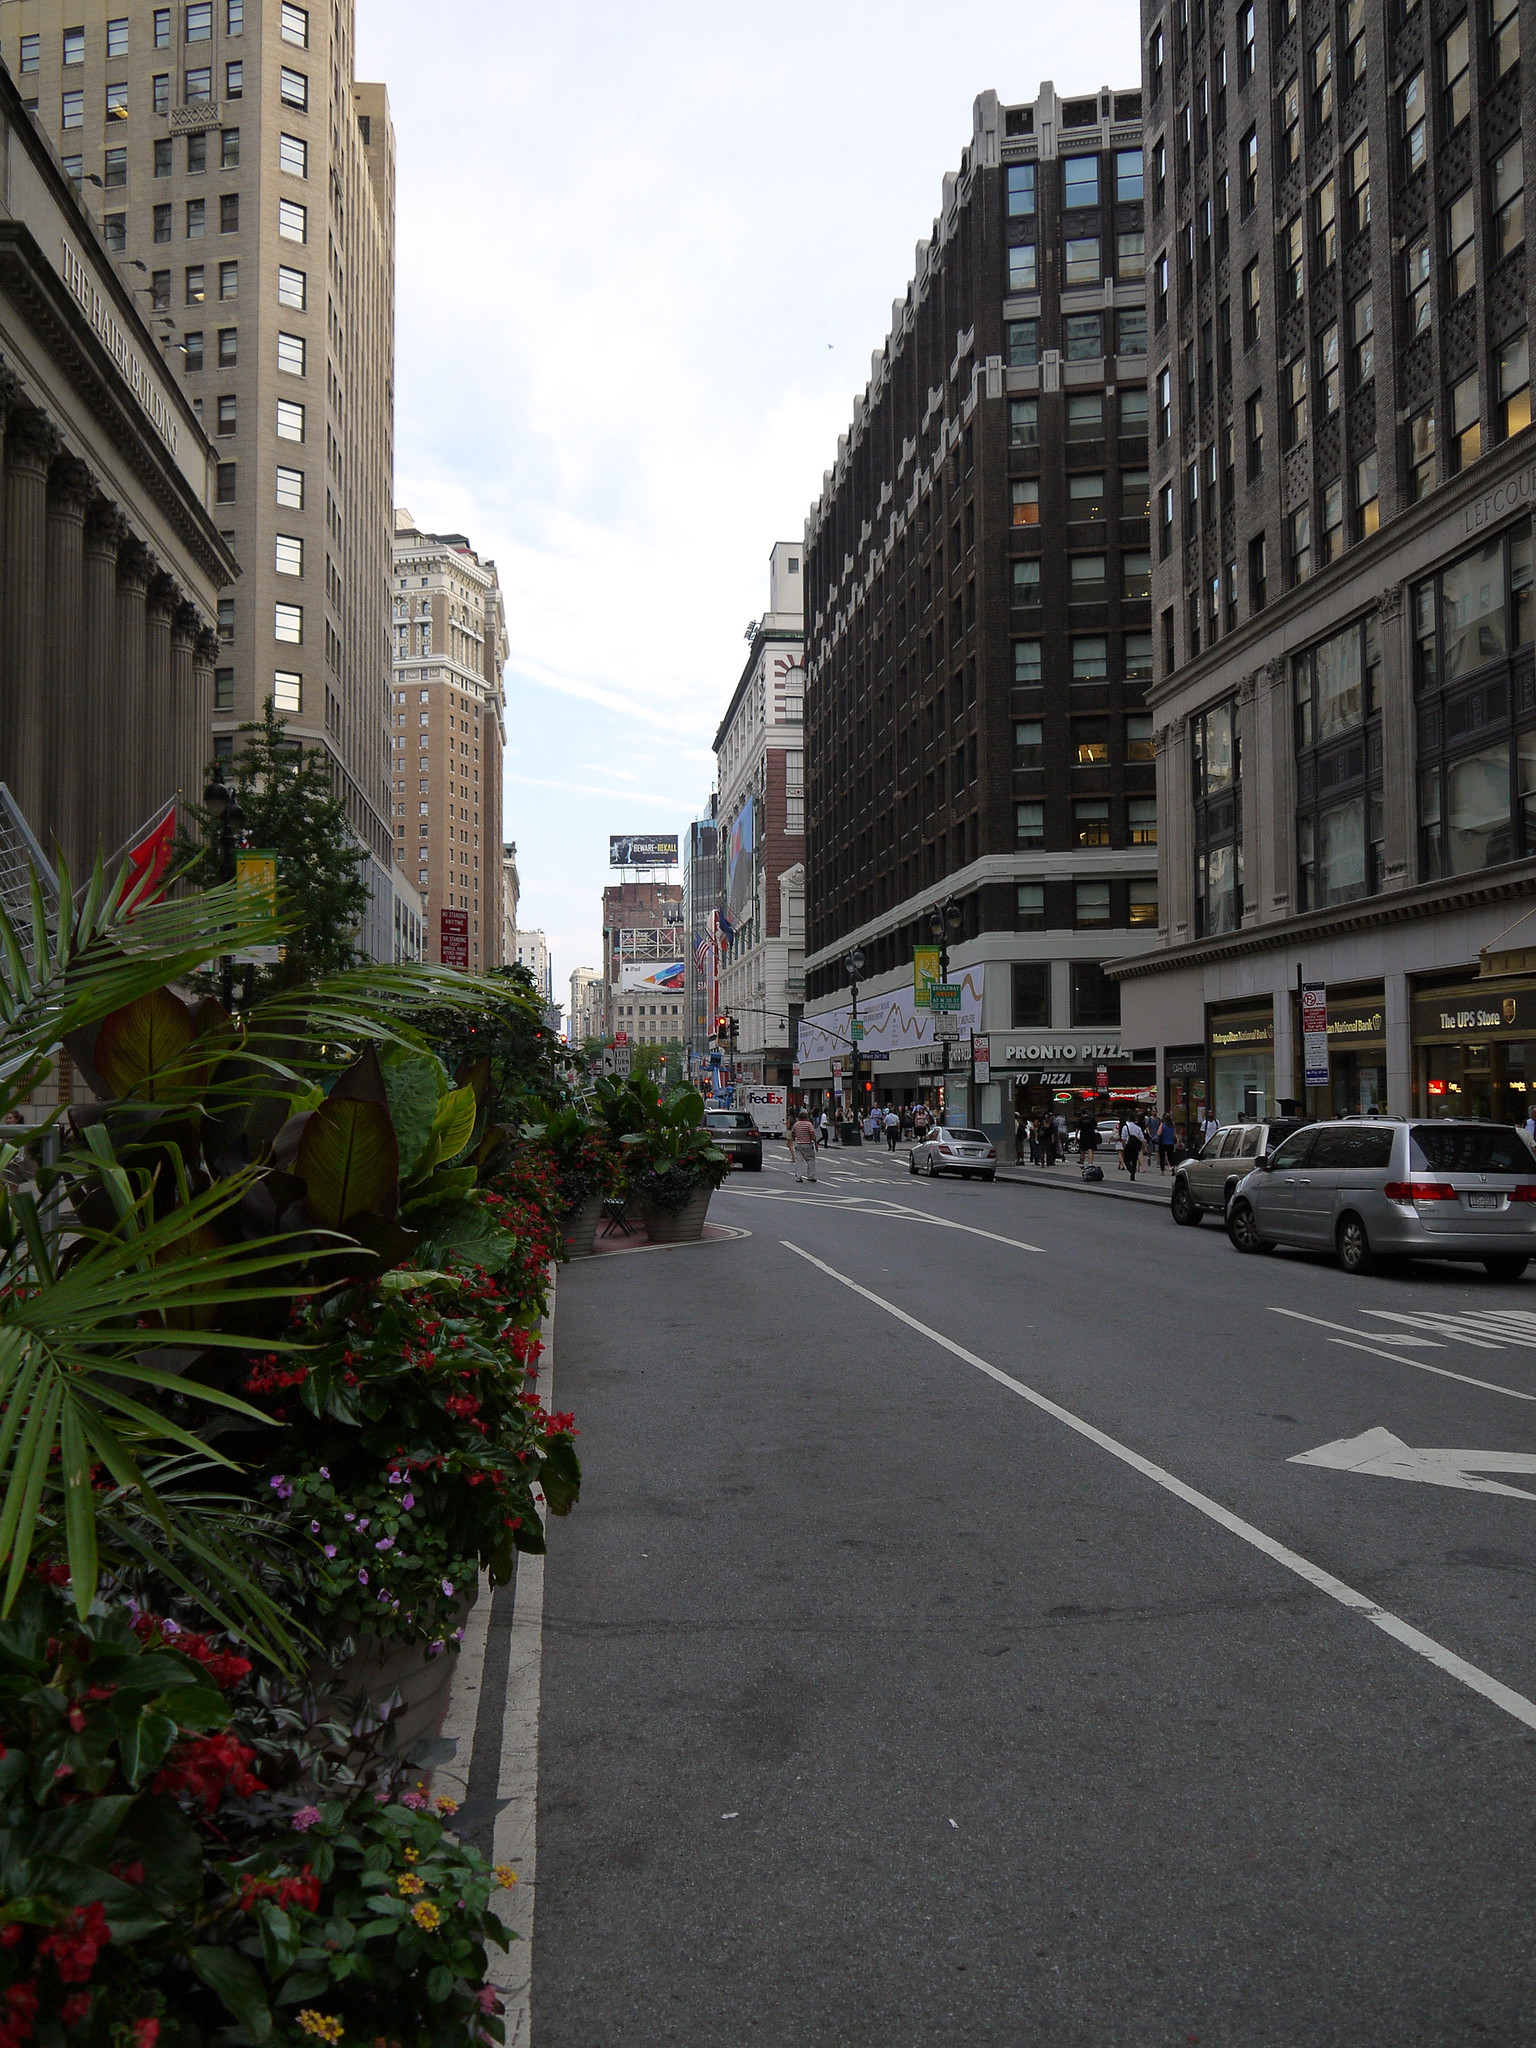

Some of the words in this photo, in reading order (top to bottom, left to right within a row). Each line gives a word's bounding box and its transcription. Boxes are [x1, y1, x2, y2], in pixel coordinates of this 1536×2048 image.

[61, 237, 90, 314] THE
[91, 287, 129, 380] HAIER
[130, 353, 178, 455] BUILDING
[1465, 466, 1536, 534] LEFCOU
[633, 843, 654, 853] BEWARE
[1334, 1019, 1358, 1033] National
[1358, 1018, 1373, 1031] Bank
[1440, 1013, 1455, 1029] The
[1457, 1011, 1475, 1028] UPS
[1477, 1010, 1500, 1026] Store
[1212, 1031, 1238, 1045] Metropolitan
[1237, 1029, 1256, 1041] National
[1256, 1028, 1267, 1039] Bank
[1005, 1045, 1077, 1059] PRONTO
[1081, 1044, 1130, 1059] PIZZA
[1040, 1073, 1071, 1085] PIZZA
[749, 1092, 783, 1104] FedEx
